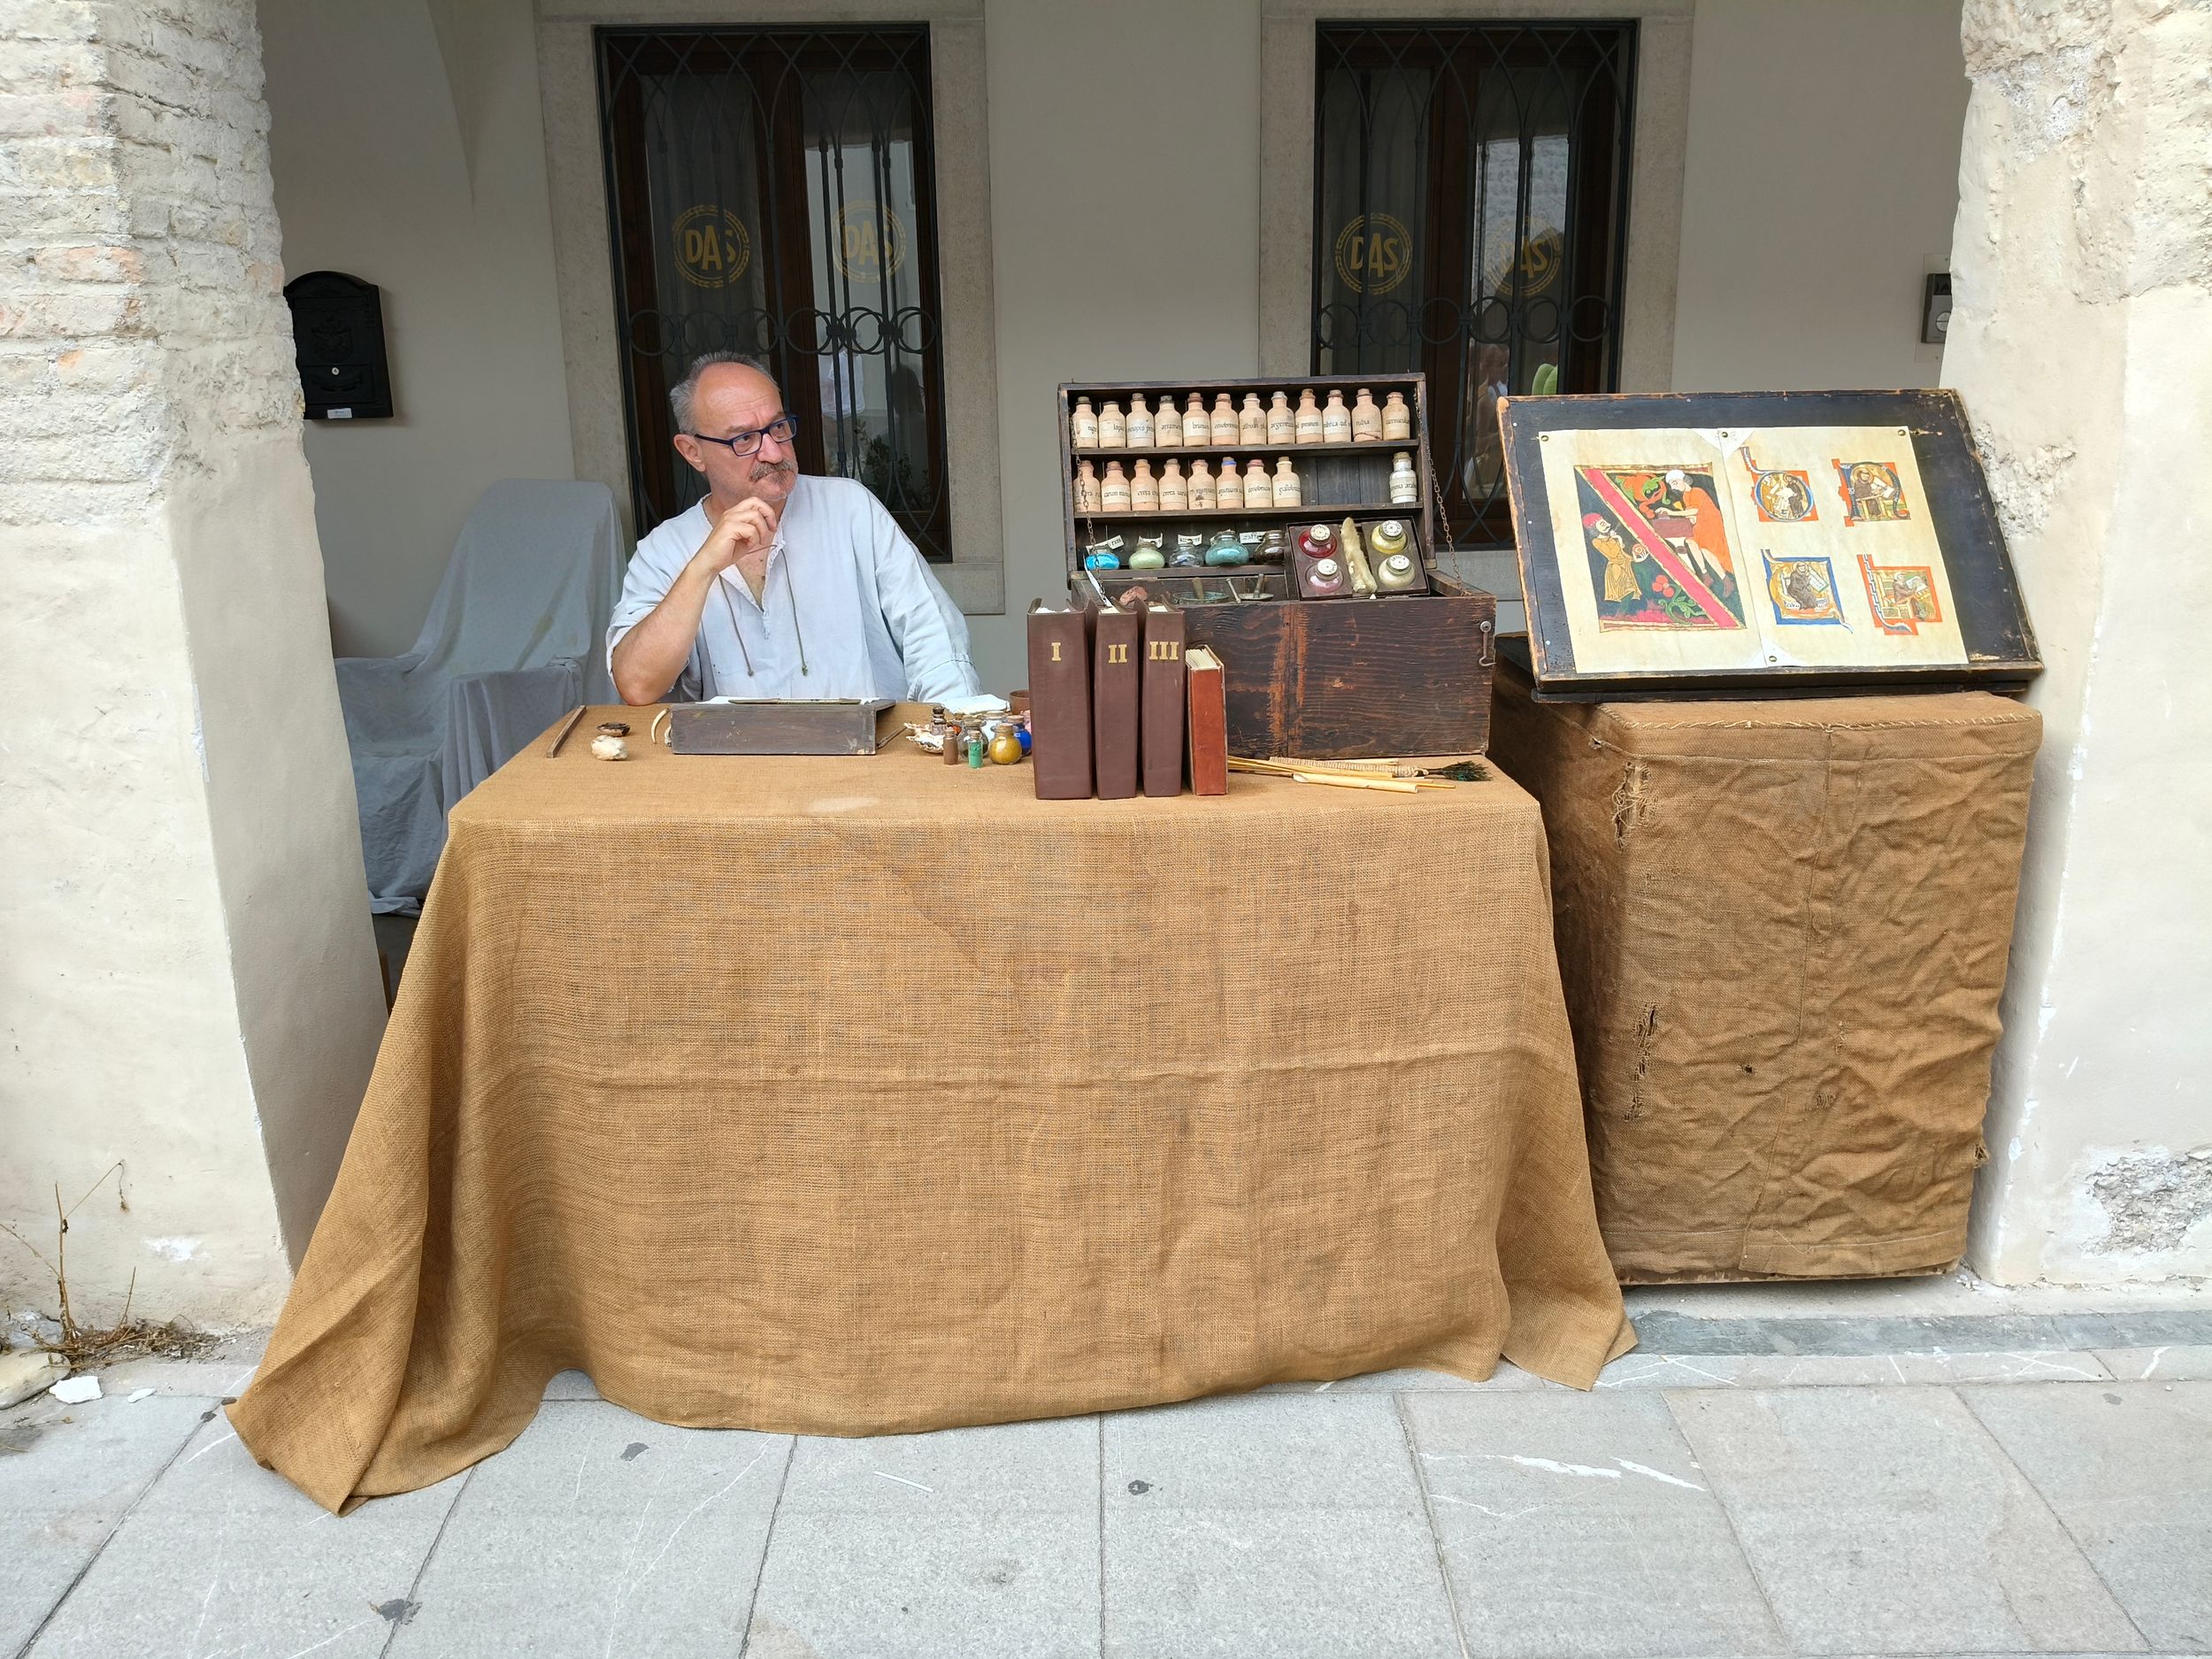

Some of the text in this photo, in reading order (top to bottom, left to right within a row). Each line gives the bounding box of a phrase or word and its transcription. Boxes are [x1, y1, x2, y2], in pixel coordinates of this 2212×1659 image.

[685, 225, 736, 271] DAS
[1350, 232, 1399, 278] DAS
[1050, 641, 1062, 662] I
[1108, 643, 1128, 664] II
[1148, 641, 1179, 661] III
